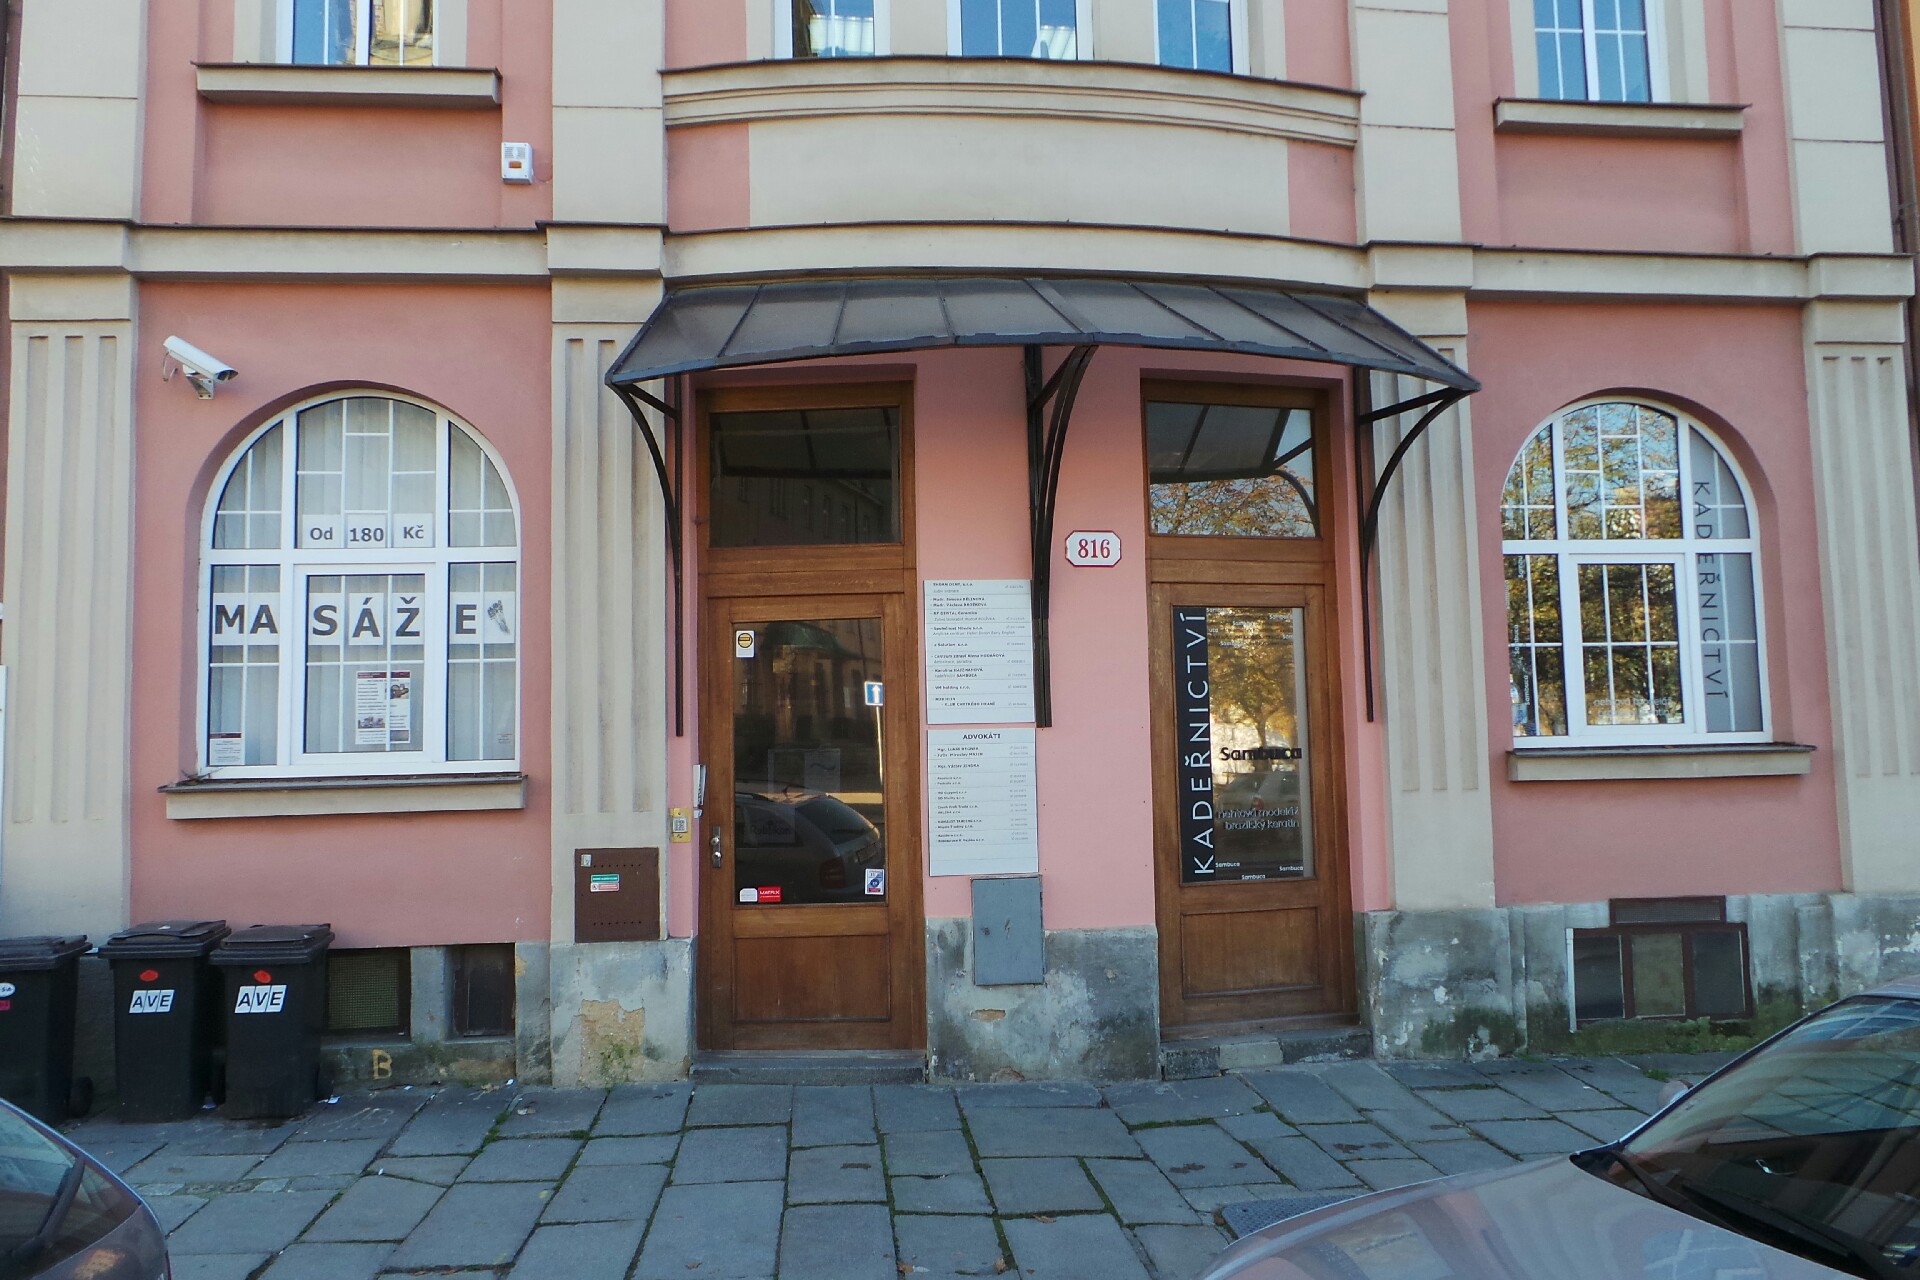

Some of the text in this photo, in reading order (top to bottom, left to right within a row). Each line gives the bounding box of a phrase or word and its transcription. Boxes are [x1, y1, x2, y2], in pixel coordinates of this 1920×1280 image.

[310, 524, 424, 542] Od 180 Kč
[1078, 538, 1110, 558] 816
[1693, 481, 1728, 699] KADEŘNICTVÍ
[214, 596, 477, 638] MASÁŽE
[1180, 612, 1215, 874] KADEŘNICTVÍ
[1220, 746, 1302, 762] Sambuca
[1218, 806, 1299, 818] nehtová modeláž
[1224, 818, 1300, 830] brazilský keratin
[132, 994, 171, 1008] AVE
[238, 991, 284, 1006] AVE
